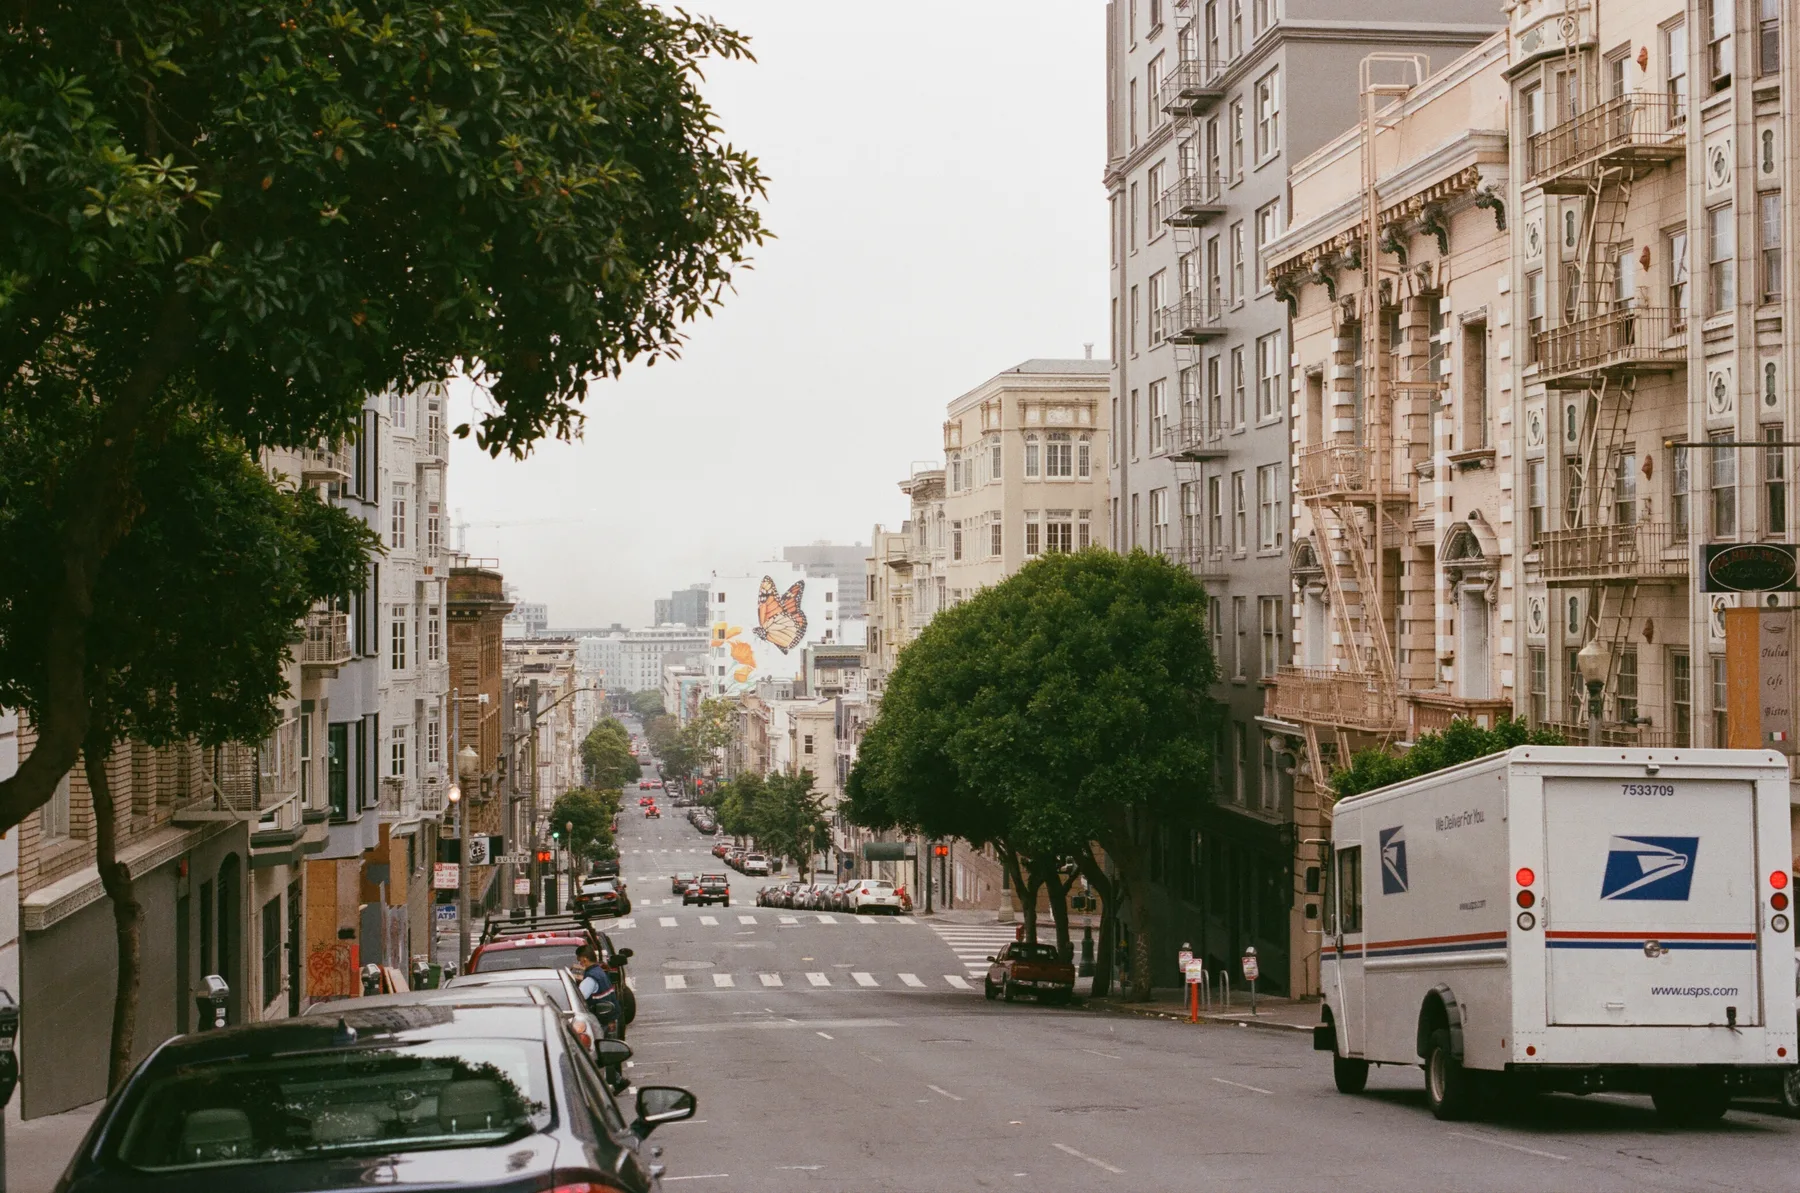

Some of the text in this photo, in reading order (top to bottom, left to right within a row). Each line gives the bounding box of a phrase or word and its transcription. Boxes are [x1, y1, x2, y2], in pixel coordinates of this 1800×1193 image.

[1761, 644, 1789, 658] Italian
[1766, 674, 1783, 690] Cafe
[1764, 705, 1788, 718] Bistro
[1621, 784, 1674, 797] 7533709
[1435, 816, 1444, 832] We
[1444, 813, 1462, 831] Deliver
[1463, 810, 1473, 827] For
[438, 912, 456, 920] ATM
[1651, 985, 1738, 997] www.usps.com
